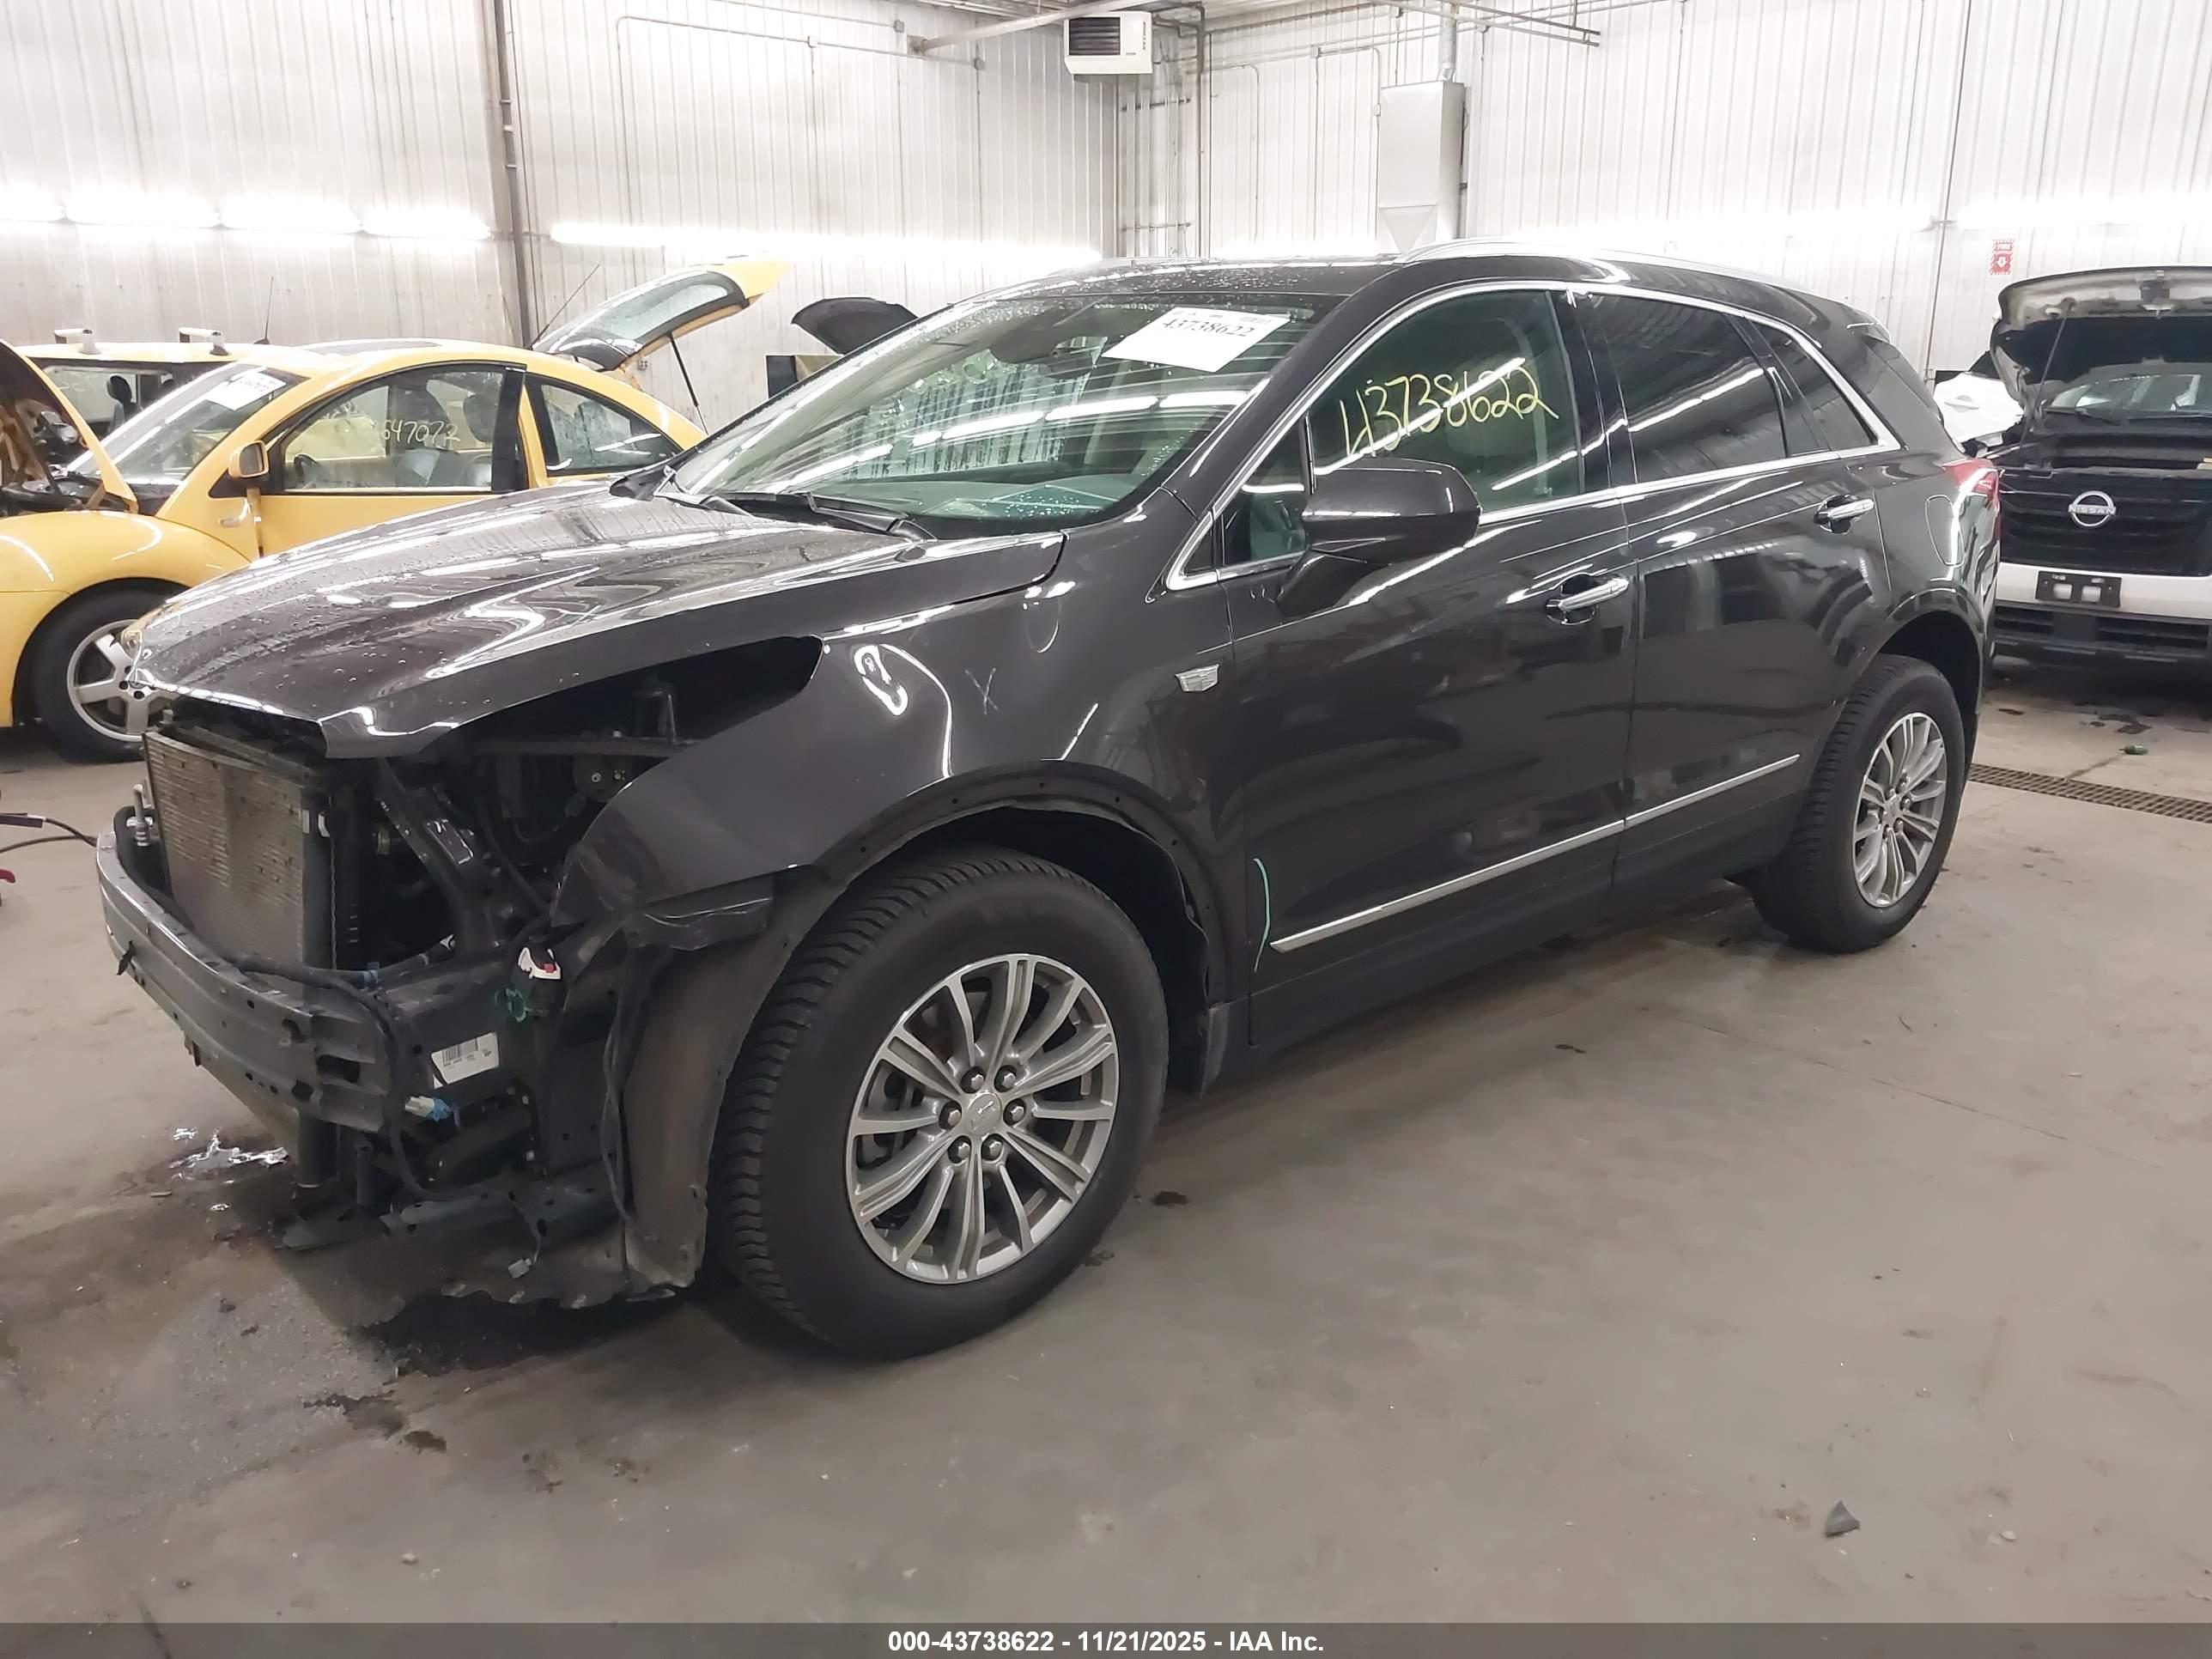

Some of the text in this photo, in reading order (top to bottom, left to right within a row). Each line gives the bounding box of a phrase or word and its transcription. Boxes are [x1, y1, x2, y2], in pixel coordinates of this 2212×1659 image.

[1163, 318, 1255, 337] 43738622
[1340, 366, 1559, 458] 43738622
[2068, 504, 2117, 516] NISSAN
